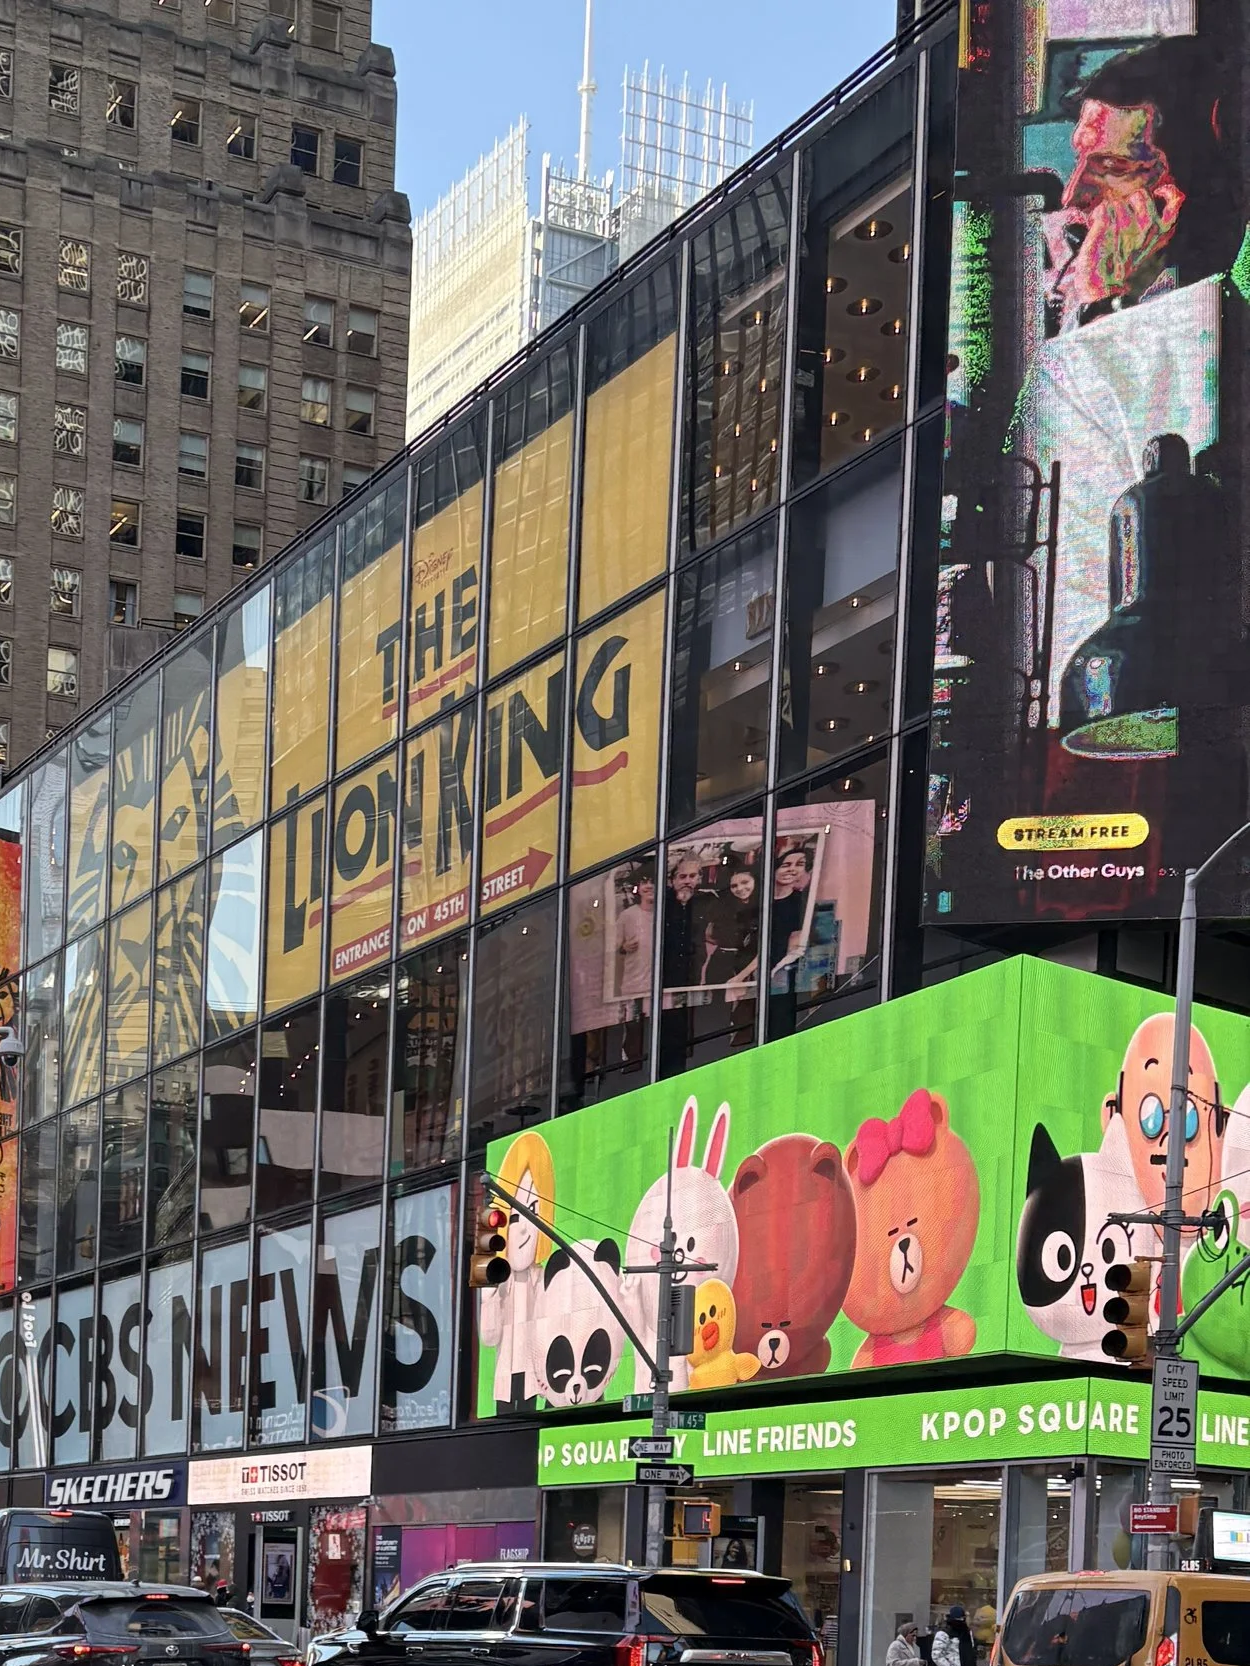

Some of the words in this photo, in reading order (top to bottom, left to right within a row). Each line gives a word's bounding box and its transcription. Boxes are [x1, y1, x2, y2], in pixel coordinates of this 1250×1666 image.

[376, 565, 479, 703] THE
[284, 752, 423, 954] LION
[434, 635, 632, 877] KING
[1013, 827, 1084, 842] STREAM
[1090, 826, 1130, 839] FREE
[1015, 865, 1045, 881] The
[1047, 864, 1097, 879] Other
[1101, 863, 1145, 880] Guys
[333, 932, 390, 971] ENTRANCE
[406, 912, 427, 935] ON
[433, 894, 466, 924] 45TH
[482, 865, 526, 901] STREET
[40, 1302, 154, 1440] CBS
[172, 1234, 440, 1421] NEWS
[1166, 1364, 1186, 1374] CITY
[1161, 1377, 1188, 1389] SPEED
[636, 1396, 641, 1409] 7
[1164, 1391, 1185, 1402] LIMIT
[679, 1414, 685, 1427] W
[687, 1414, 697, 1428] 45
[920, 1407, 1007, 1442] KPOP
[1017, 1400, 1140, 1436] SQUARE
[1202, 1413, 1250, 1446] LINE
[1157, 1406, 1191, 1438] 25
[703, 1425, 752, 1457] LINE
[756, 1418, 858, 1454] FRIENDS
[634, 1442, 648, 1452] ONE
[654, 1442, 669, 1451] WAY
[1161, 1450, 1185, 1461] PHOTO
[260, 1462, 307, 1482] TISSOT
[1154, 1459, 1192, 1471] ENFORCED
[644, 1471, 662, 1479] ONE
[669, 1471, 686, 1479] WAY
[49, 1469, 174, 1506] SKECHERS
[261, 1510, 290, 1522] TISSOT
[16, 1548, 107, 1572] Mr.Shirt
[500, 1548, 529, 1561] FLAGSHIP
